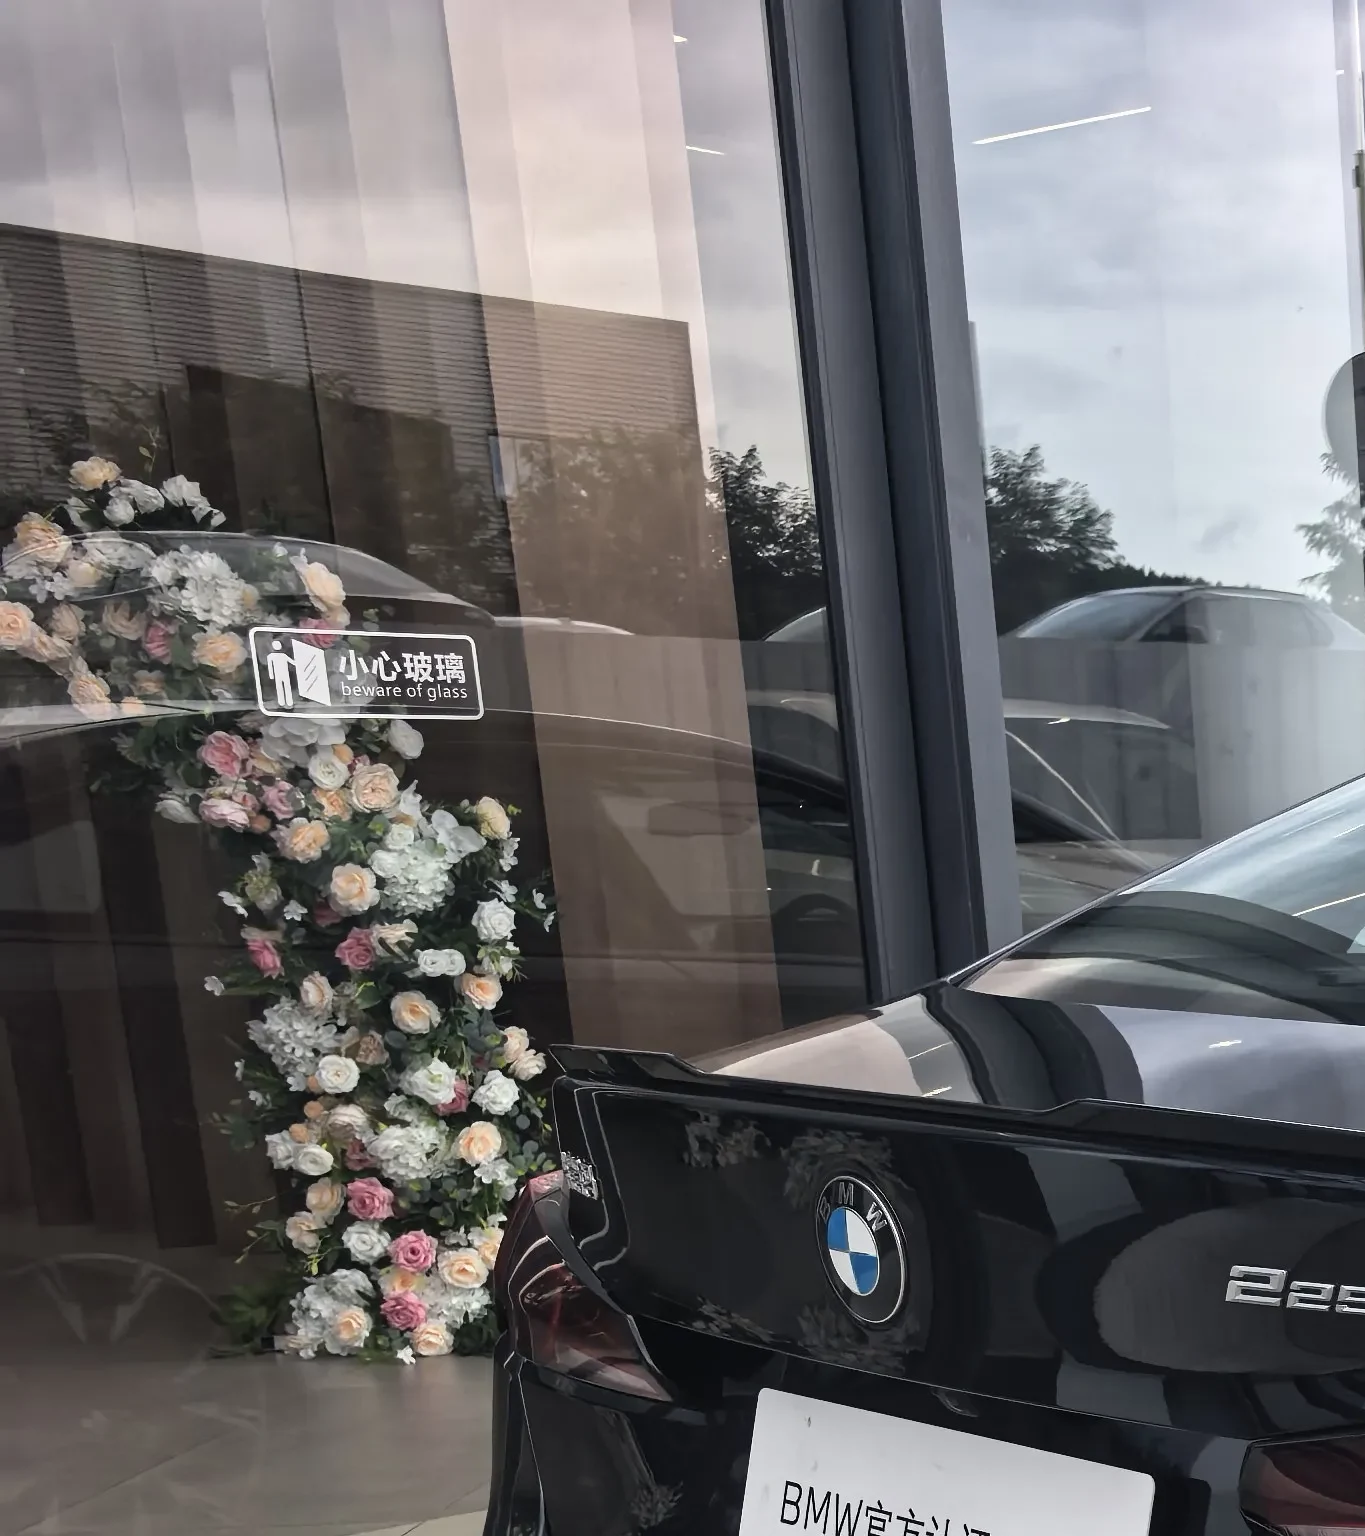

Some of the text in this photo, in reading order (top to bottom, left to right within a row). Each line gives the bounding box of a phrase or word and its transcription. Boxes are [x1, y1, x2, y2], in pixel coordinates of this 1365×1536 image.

[339, 649, 466, 684] 小心玻璃
[341, 681, 468, 702] beware of glass
